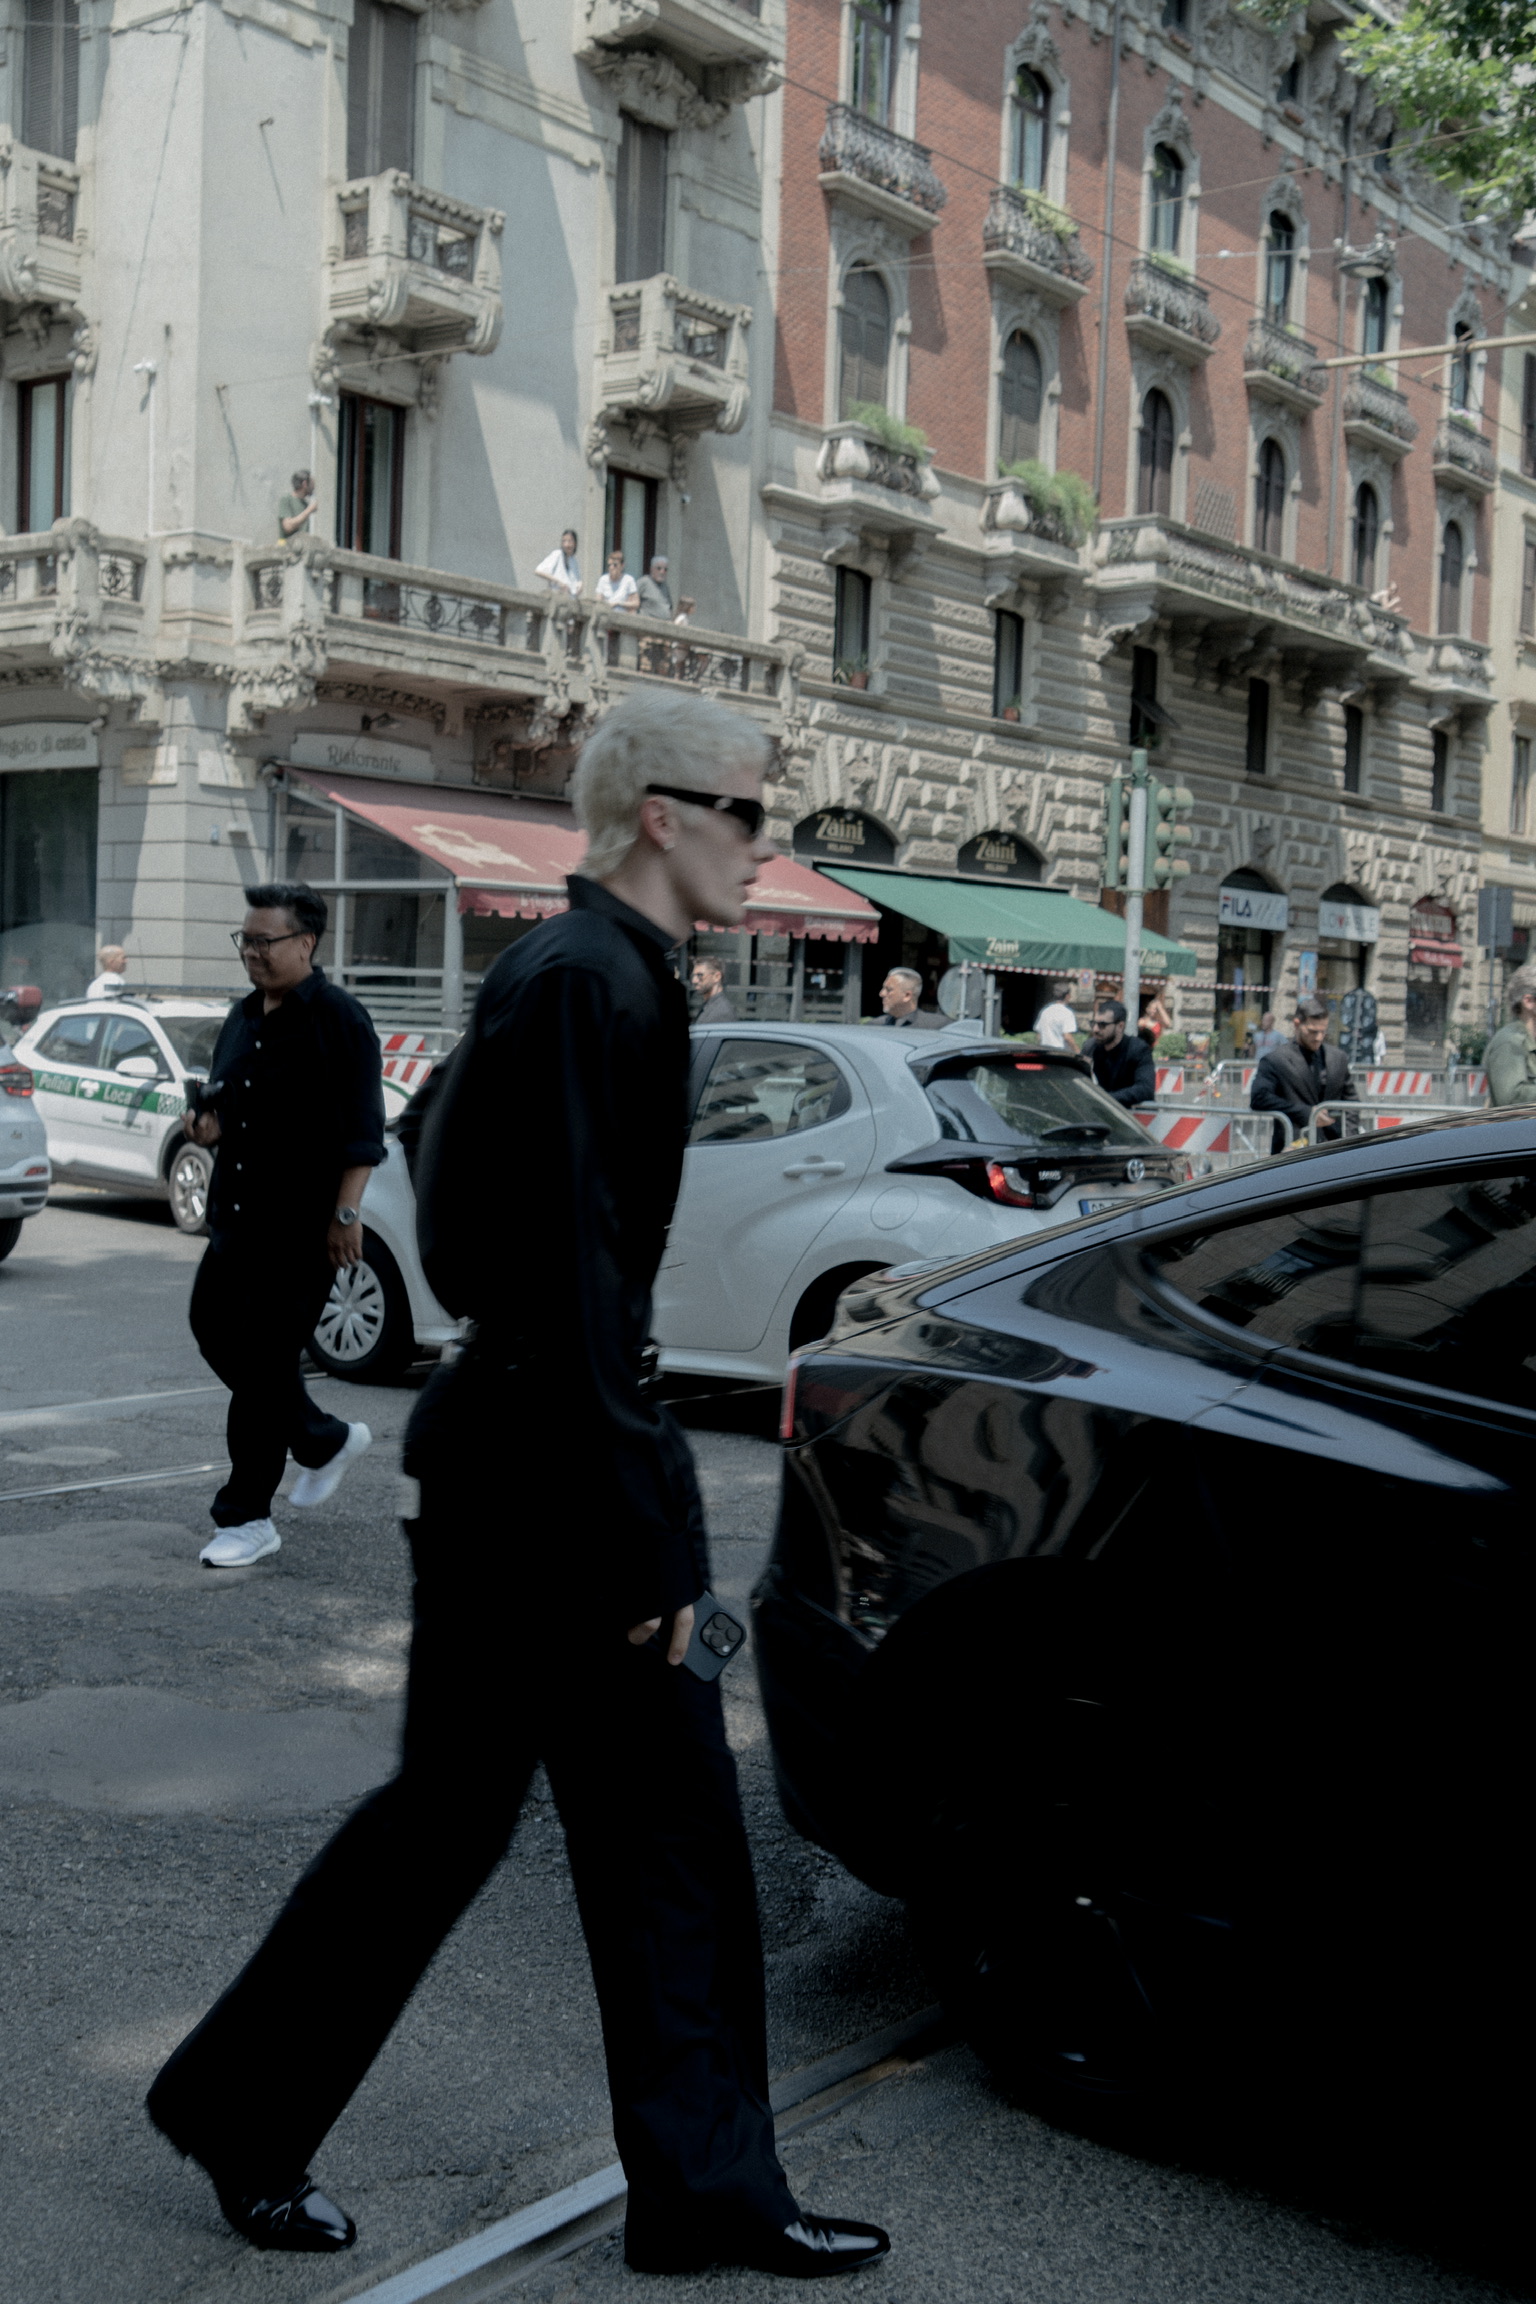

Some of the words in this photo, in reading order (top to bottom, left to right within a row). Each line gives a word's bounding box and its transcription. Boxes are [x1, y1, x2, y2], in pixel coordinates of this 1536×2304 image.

[328, 744, 401, 771] Ristorante
[1222, 896, 1252, 917] FILA
[38, 1073, 73, 1094] Polizia
[103, 1083, 144, 1107] Locale
